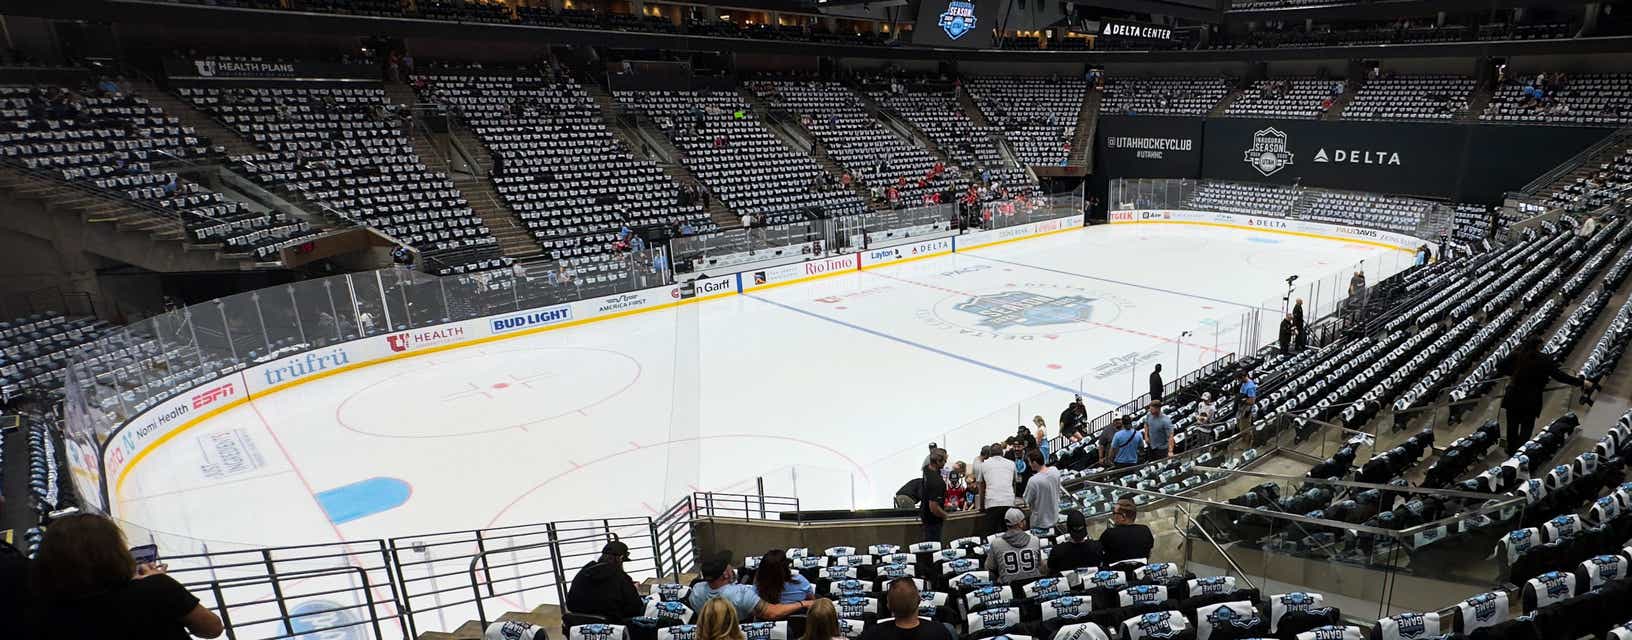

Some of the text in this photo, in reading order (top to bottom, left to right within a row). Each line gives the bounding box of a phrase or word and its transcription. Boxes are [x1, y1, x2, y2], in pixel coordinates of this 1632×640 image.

[950, 7, 971, 17] SEASON
[1113, 24, 1171, 39] DELTA CENTER
[219, 62, 259, 72] HEALTH
[261, 63, 294, 73] PLANS
[1107, 136, 1192, 151] @UTAHHOCKEYCLUB
[1255, 142, 1284, 153] SEASON
[1334, 149, 1401, 165] DELTA
[1256, 218, 1287, 229] DELTA
[920, 241, 948, 253] DELTA
[871, 249, 893, 260] Layton
[704, 279, 730, 293] Garff
[600, 299, 646, 312] AMERICA FIRST
[494, 308, 569, 331] BUD LIGHT
[414, 327, 464, 343] HEALTH
[264, 348, 350, 385] trüfrü
[192, 383, 235, 409] ESPN
[136, 404, 189, 440] Nomi Health
[1003, 550, 1036, 574] 99
[1132, 592, 1155, 601] GAME
[1057, 605, 1079, 615] GAME
[983, 612, 1006, 622] GAME
[1400, 617, 1424, 628] GAME
[1146, 619, 1169, 634] GAME
[747, 628, 770, 638] GAME
[1316, 629, 1345, 640] GAME
